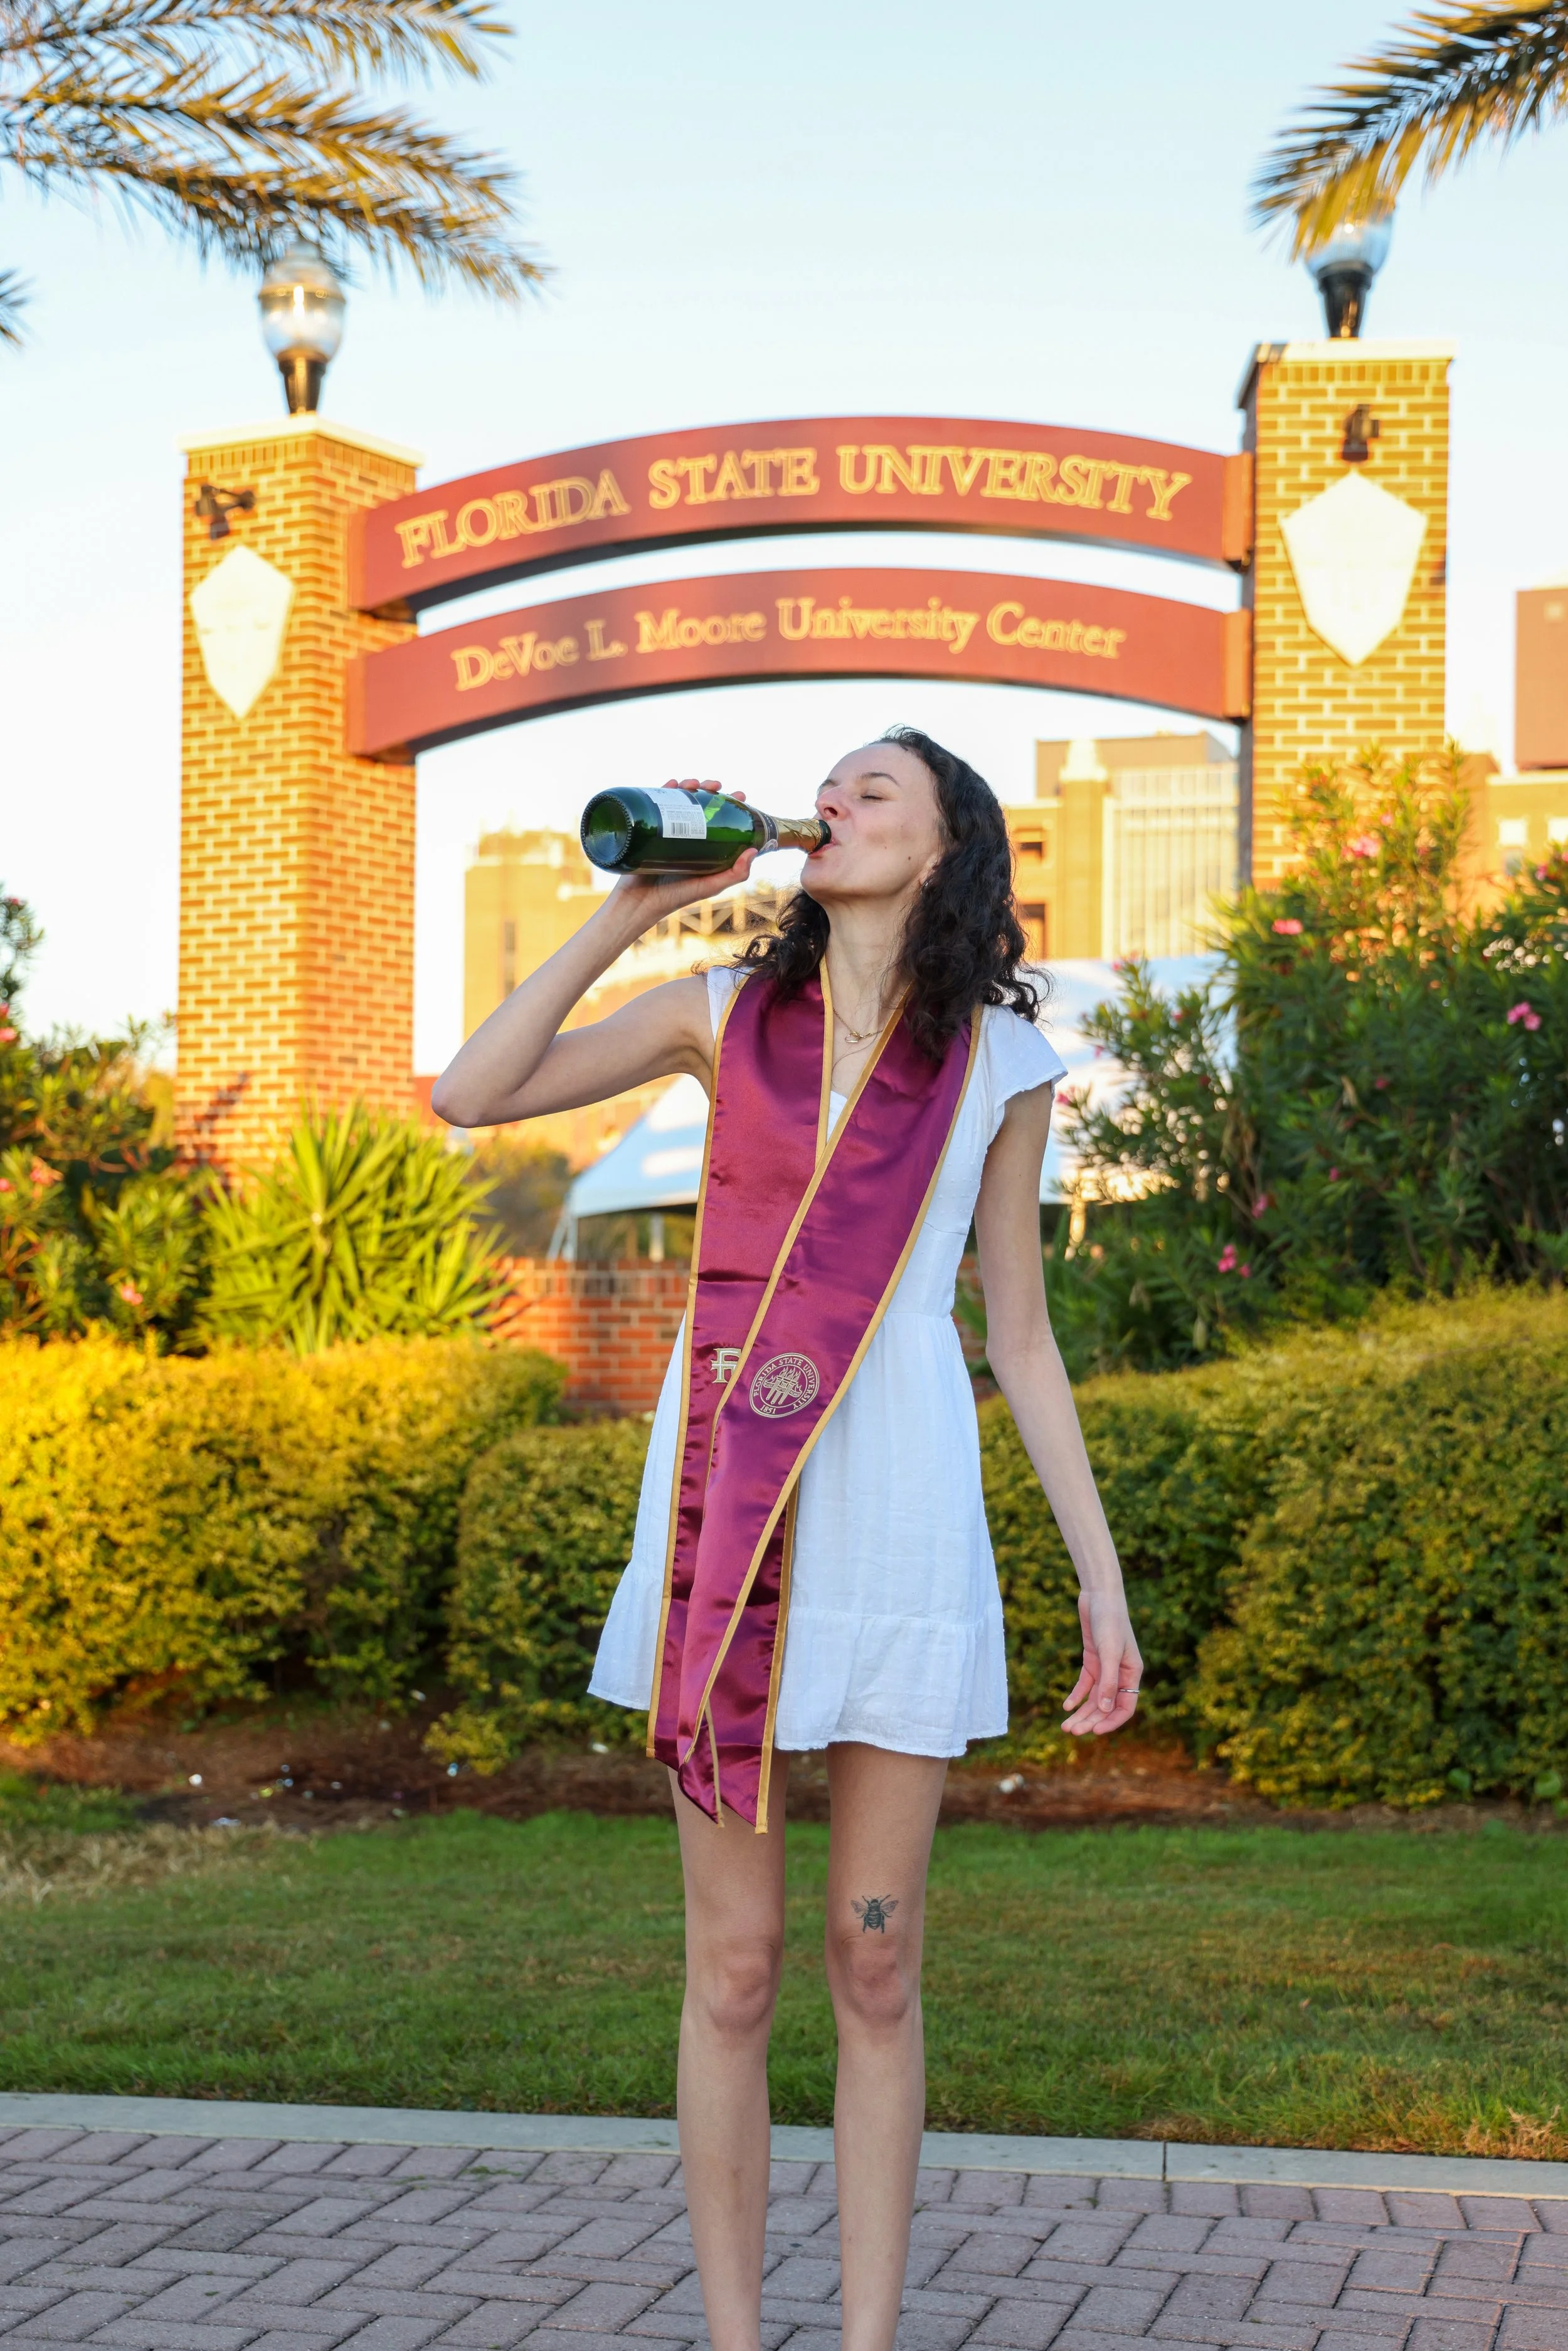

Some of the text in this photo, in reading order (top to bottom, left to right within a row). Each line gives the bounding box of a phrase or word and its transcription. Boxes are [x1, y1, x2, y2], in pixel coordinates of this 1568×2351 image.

[395, 445, 1193, 569] FLORIDA STATE UNIVERSITY
[450, 595, 1128, 691] DeVoe L. Moore University Center
[753, 1357, 815, 1409] FLORIDA STATE UNIVERSITY
[760, 1404, 776, 1414] 1851
